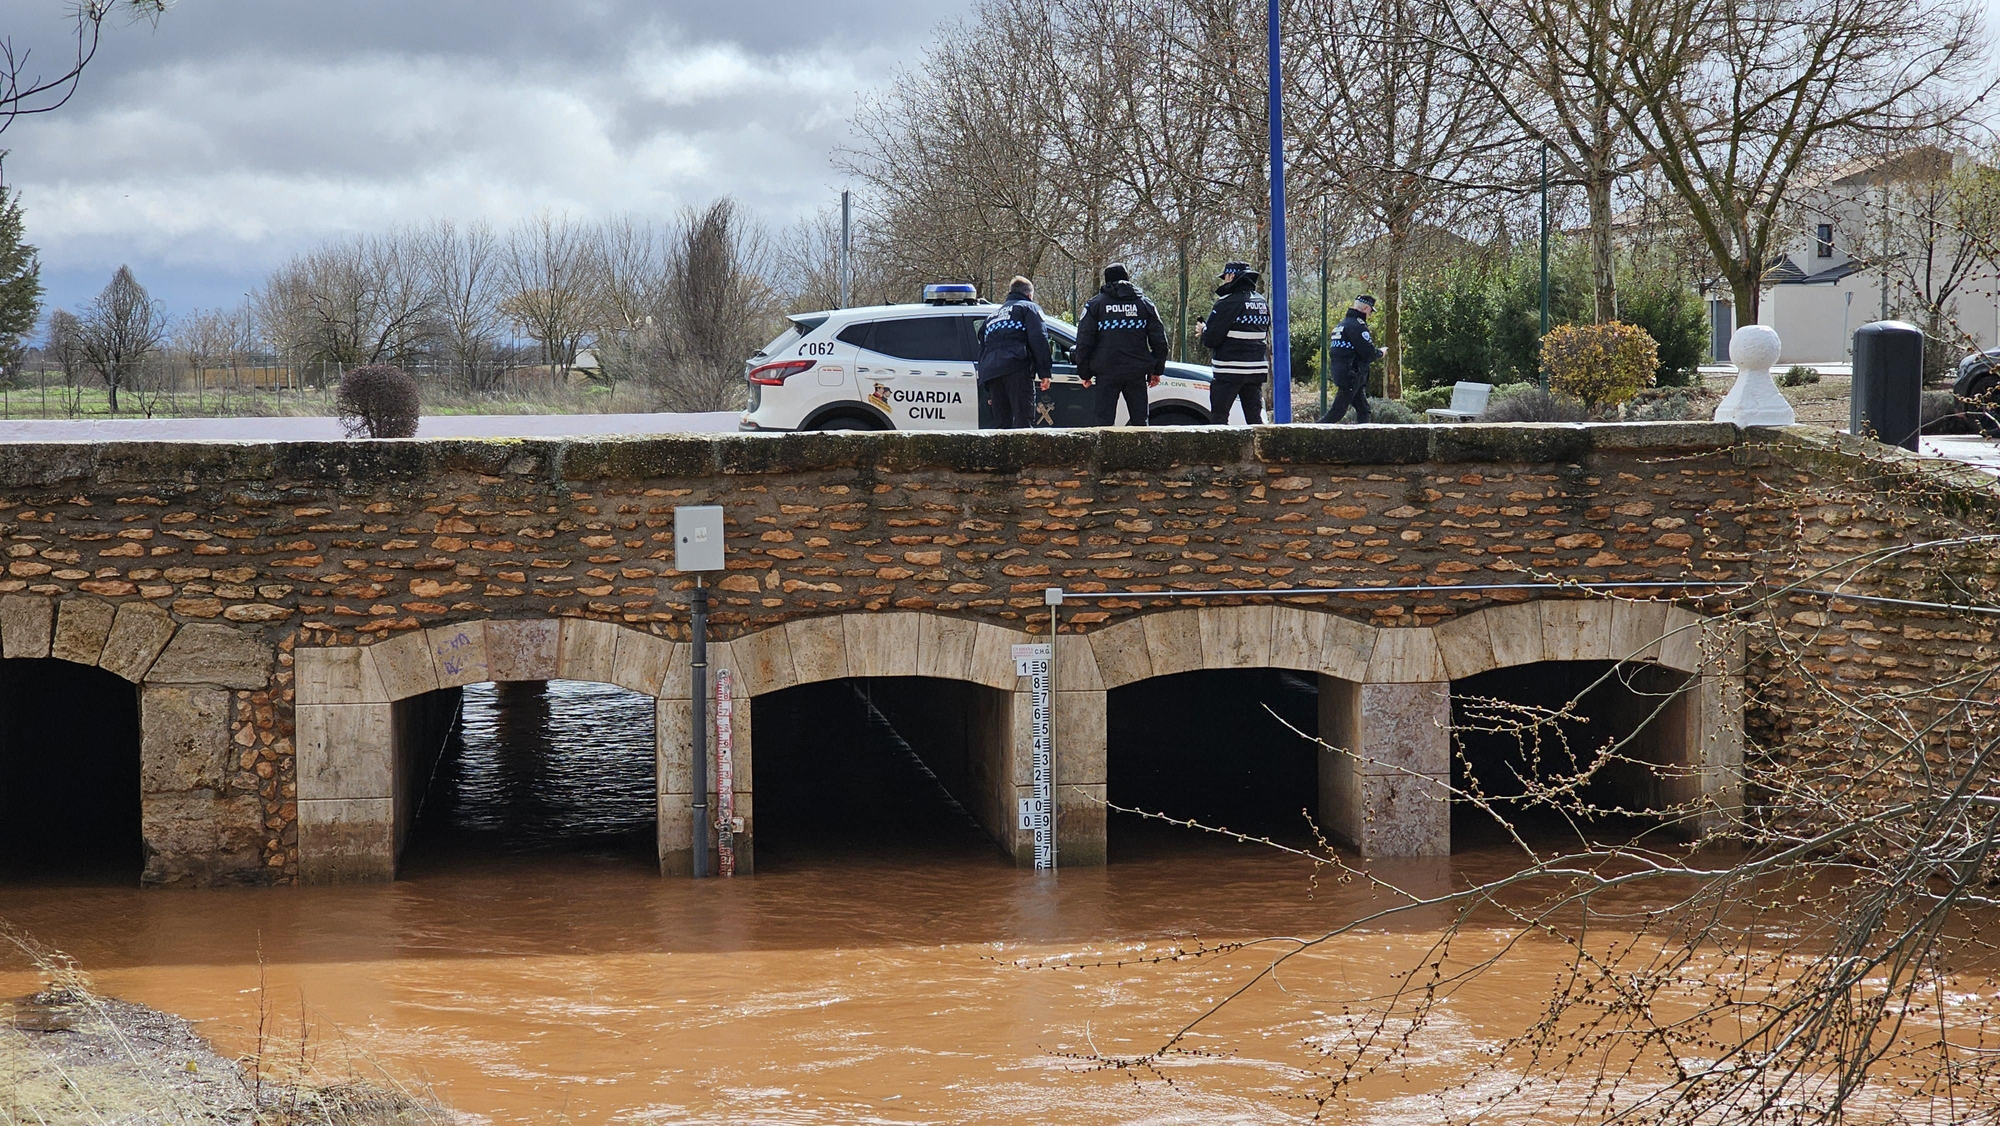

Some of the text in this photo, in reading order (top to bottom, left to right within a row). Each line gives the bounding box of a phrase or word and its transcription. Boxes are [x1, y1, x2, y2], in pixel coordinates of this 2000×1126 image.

[1105, 304, 1138, 313] POLICIA
[809, 342, 834, 356] 062
[893, 390, 962, 404] GUARDIA
[909, 407, 946, 420] CIVIL
[1040, 661, 1047, 673] 9
[1033, 677, 1040, 689] 8
[1041, 692, 1047, 704] 7
[1034, 708, 1041, 720] 6
[1042, 723, 1049, 735] 5
[1034, 738, 1041, 750] 4
[1042, 754, 1049, 766] 3
[1034, 769, 1041, 781] 2
[1043, 785, 1048, 796] 1
[1043, 815, 1050, 827] 9
[1036, 831, 1043, 843] 8
[1043, 846, 1050, 858] 7
